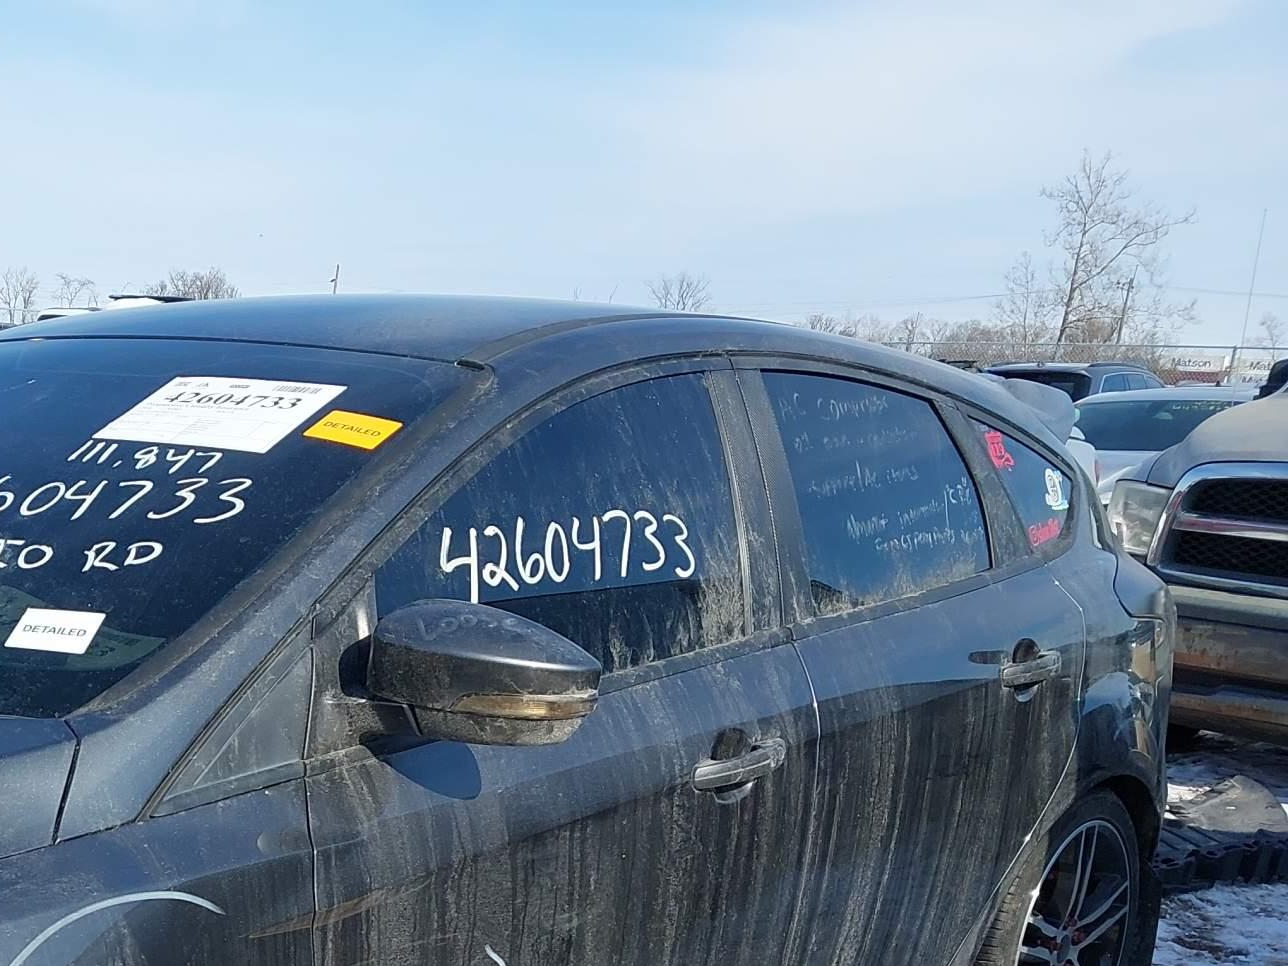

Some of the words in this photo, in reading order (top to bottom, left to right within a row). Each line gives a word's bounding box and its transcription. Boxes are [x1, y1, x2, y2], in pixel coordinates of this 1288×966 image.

[164, 391, 303, 410] 42604733
[323, 420, 381, 438] DETAILED
[82, 541, 163, 572] RD
[439, 509, 696, 604] 42604733
[22, 624, 88, 638] DETAILED
